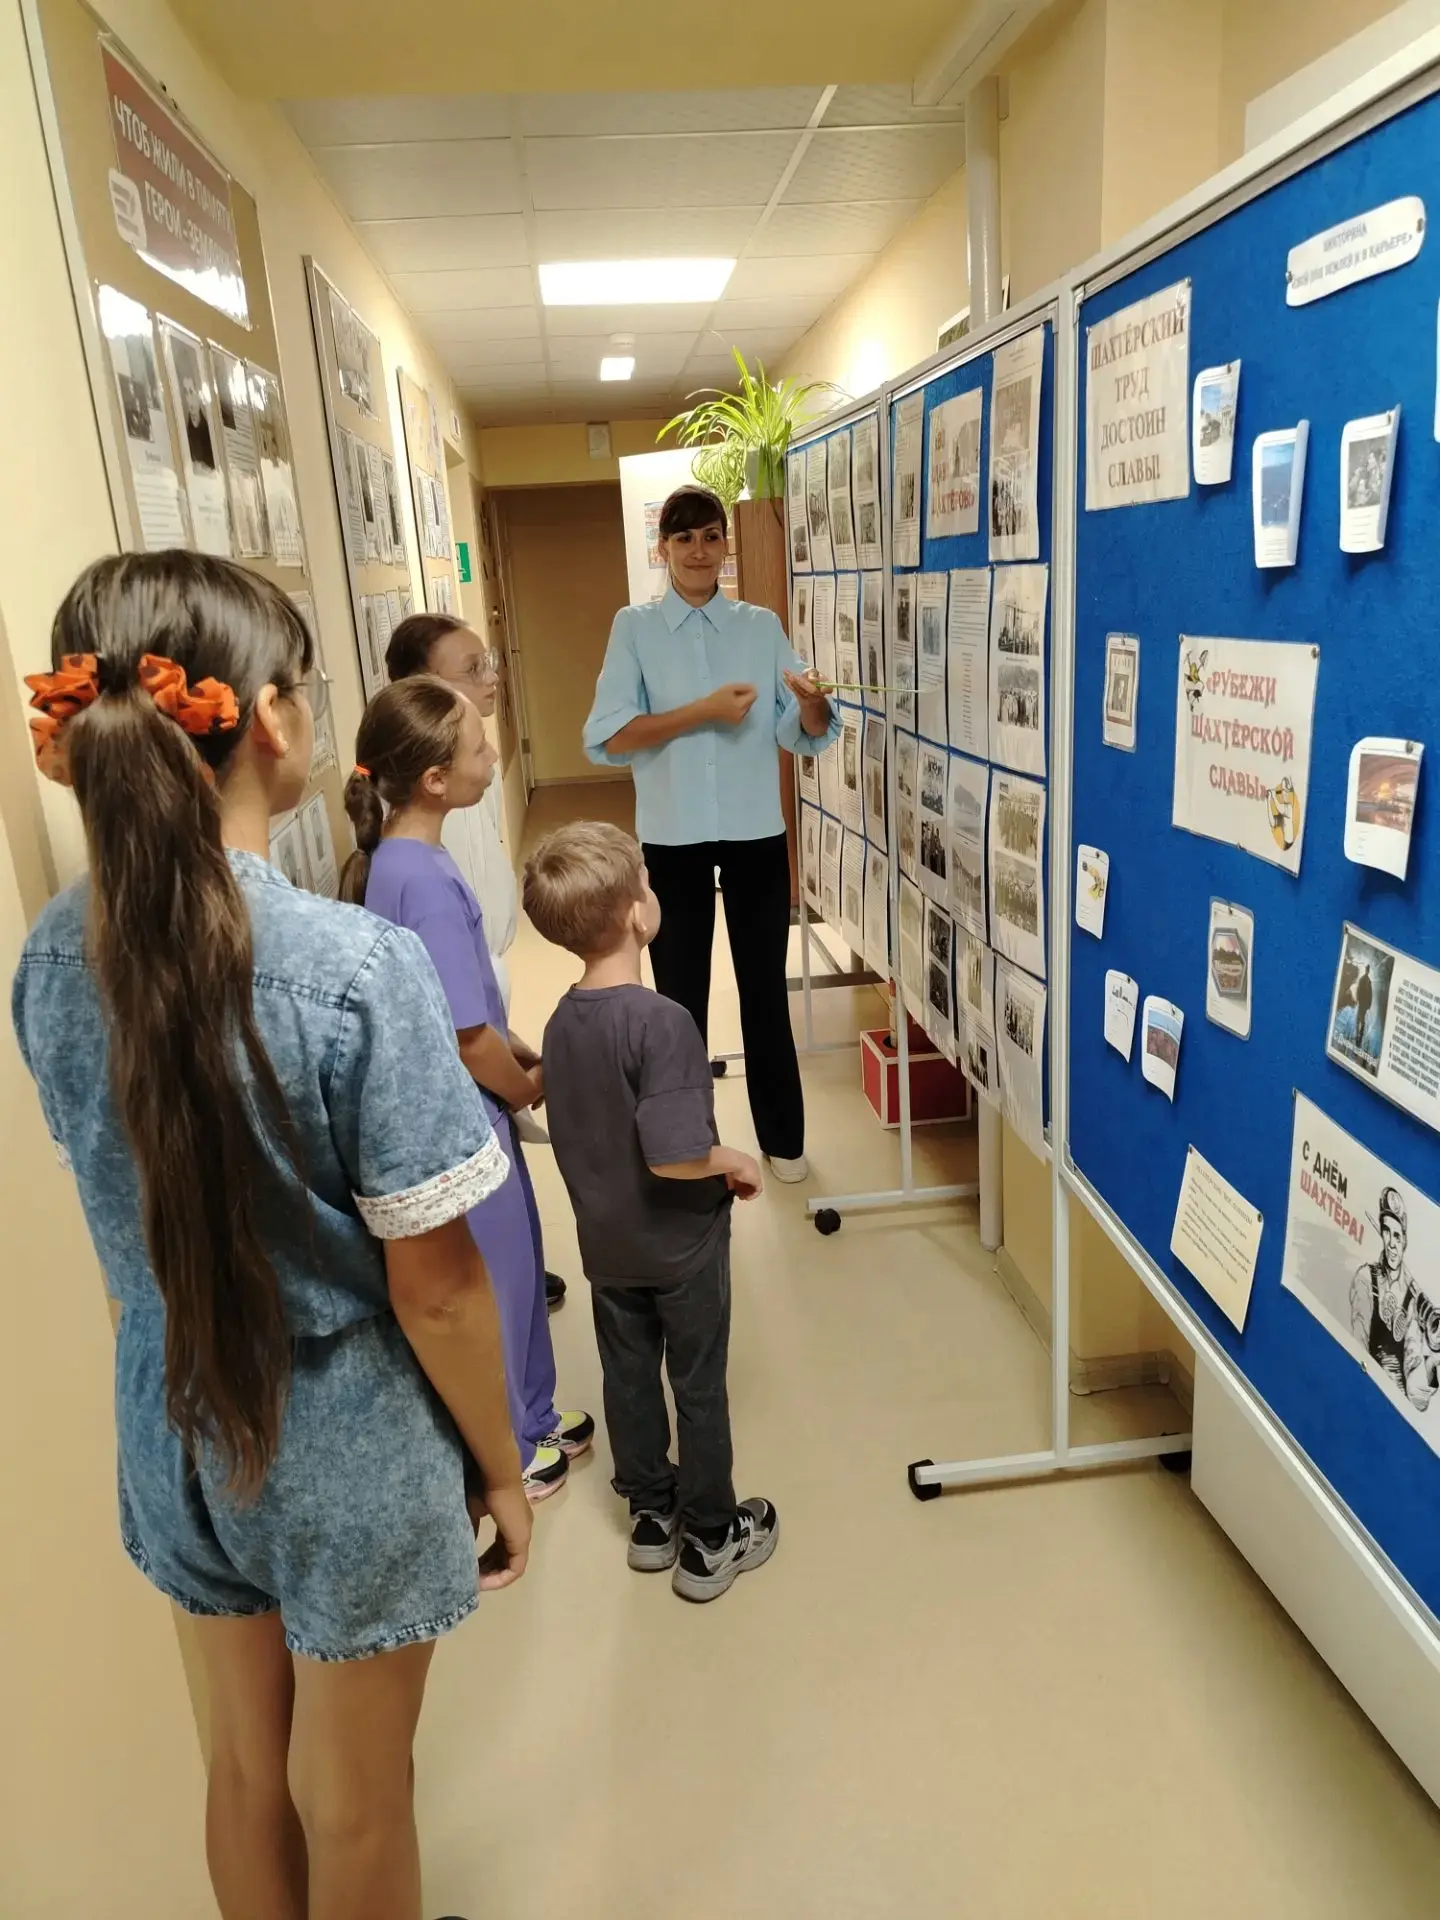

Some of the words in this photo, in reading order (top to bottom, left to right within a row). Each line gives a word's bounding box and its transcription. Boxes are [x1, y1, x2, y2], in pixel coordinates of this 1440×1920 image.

[114, 94, 151, 158] ЧТОБ
[1091, 302, 1186, 371] ШАХТЁРСКИЙ
[1114, 366, 1150, 403] ТРУД
[1100, 406, 1166, 455] ДОСТОИН
[1107, 453, 1161, 489] СЛАВЫ!
[1206, 669, 1277, 709] «РУБЕЖИ
[1302, 1140, 1310, 1161] С
[1313, 1151, 1348, 1199] ДНЁМ
[1300, 1168, 1365, 1246] ШАХТЁРА!
